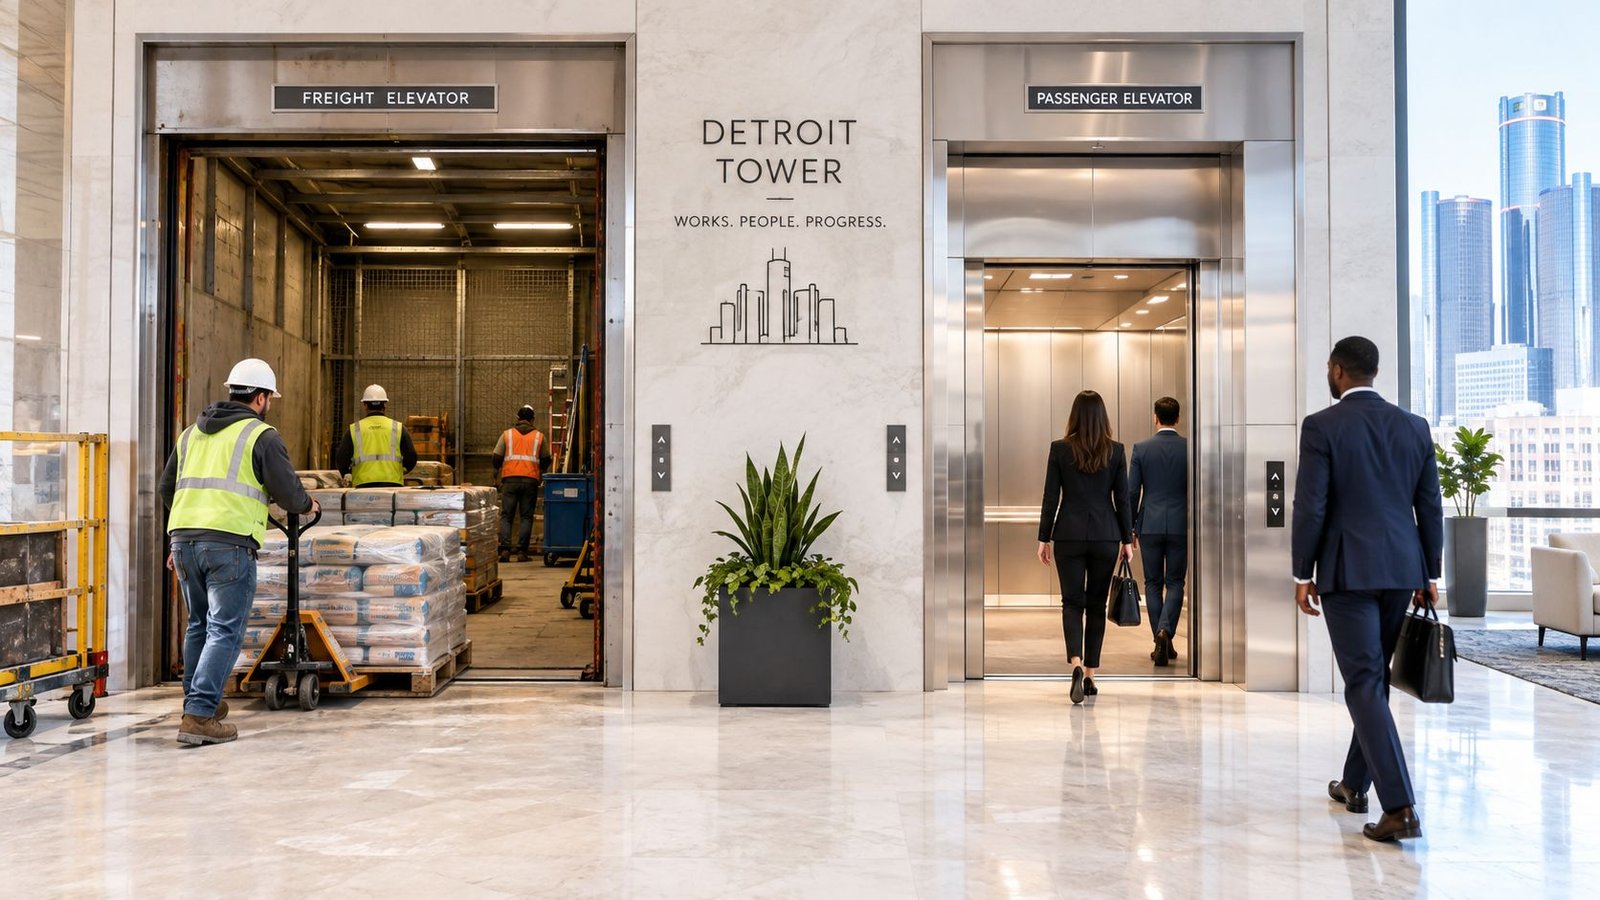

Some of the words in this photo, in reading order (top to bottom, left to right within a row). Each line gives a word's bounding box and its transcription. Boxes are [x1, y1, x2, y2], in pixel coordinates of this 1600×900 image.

[302, 91, 375, 105] FREIGHT
[387, 91, 470, 105] ELEVATOR
[1037, 92, 1118, 105] PASSENGER
[1123, 92, 1193, 105] ELEVATOR
[702, 119, 857, 146] DETROIT
[716, 158, 842, 184] TOWER
[674, 215, 734, 228] WORKS.
[739, 215, 800, 228] PEOPLE.
[805, 215, 887, 228] PROGRESS.
